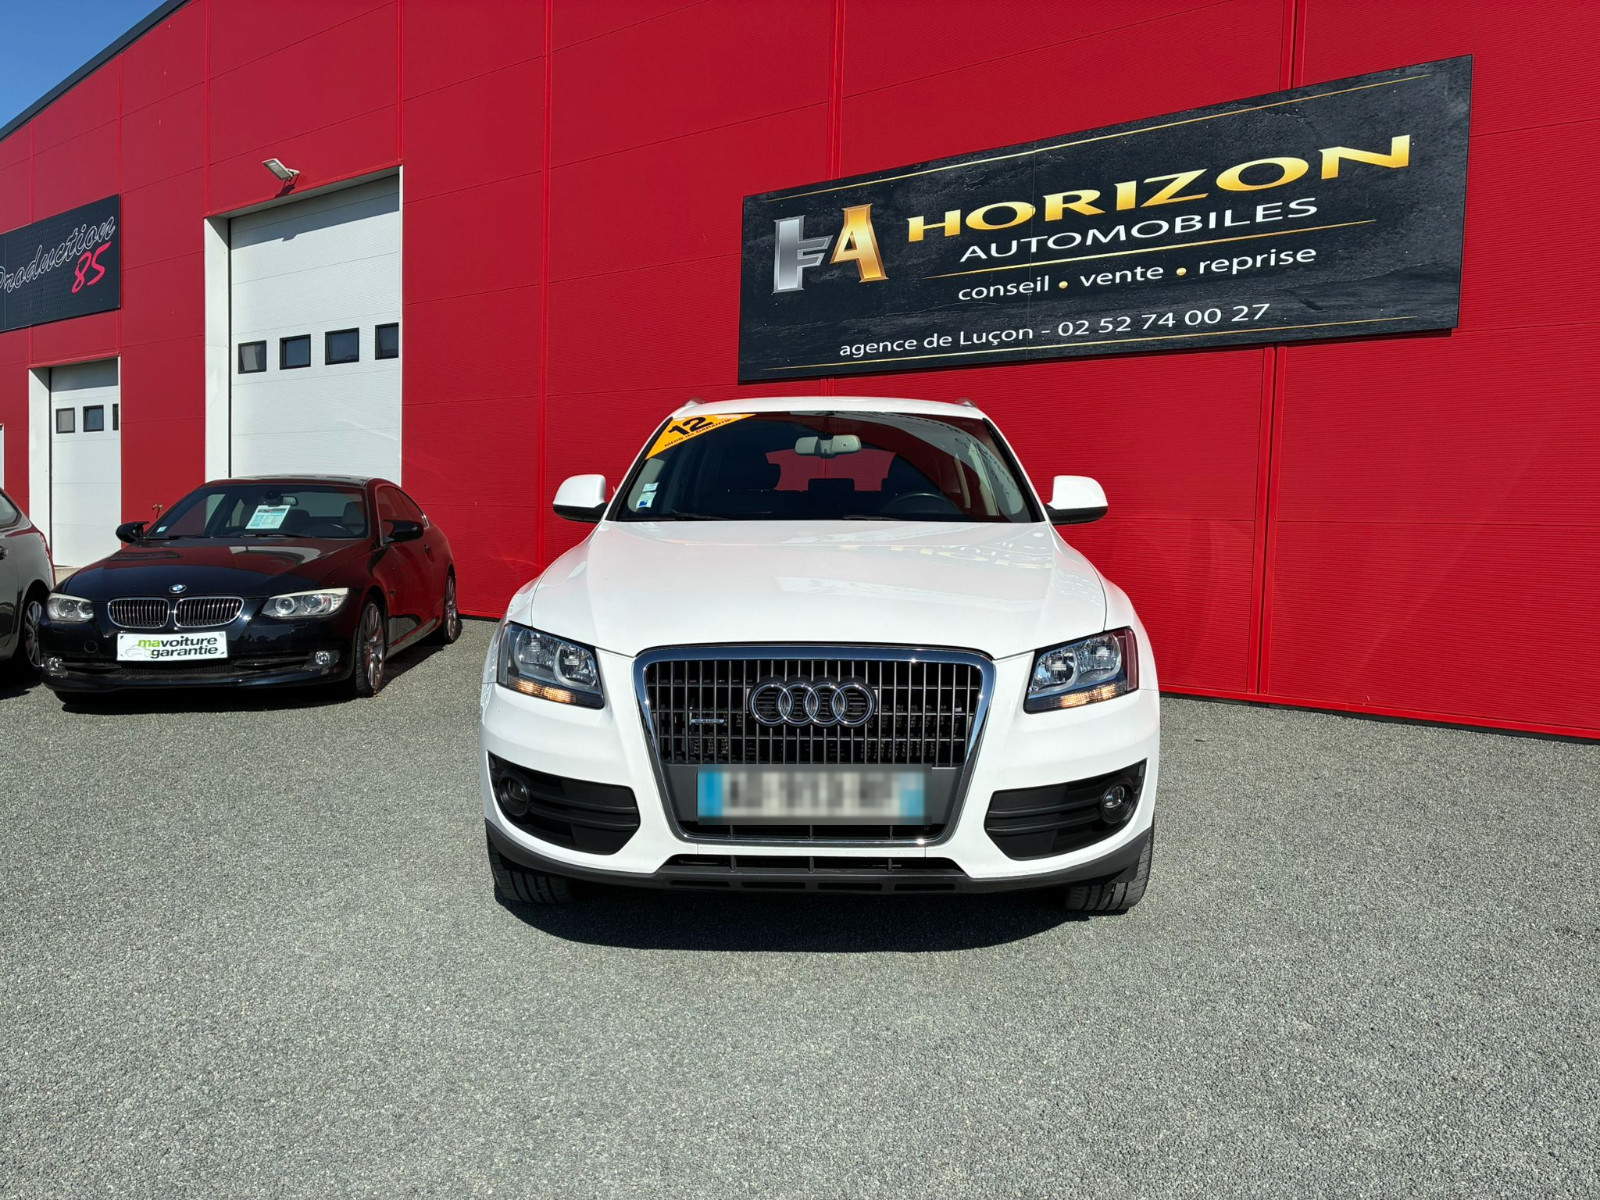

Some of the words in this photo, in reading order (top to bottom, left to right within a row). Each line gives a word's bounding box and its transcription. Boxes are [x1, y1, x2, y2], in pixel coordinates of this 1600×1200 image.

[907, 134, 1411, 242] HORIZON
[960, 197, 1318, 263] AUTOMOBILES
[72, 241, 111, 293] 85
[958, 275, 1049, 300] conseil
[1080, 265, 1164, 287] vente
[1200, 247, 1317, 275] reprise
[839, 338, 918, 358] agence
[923, 333, 952, 349] de
[960, 326, 1033, 346] Luçon
[1058, 319, 1090, 337] 02
[1099, 316, 1132, 334] 52
[1141, 312, 1176, 330] 74
[1184, 308, 1222, 326] 00
[1231, 303, 1270, 321] 27
[668, 417, 714, 435] 12
[151, 646, 218, 659] garantie
